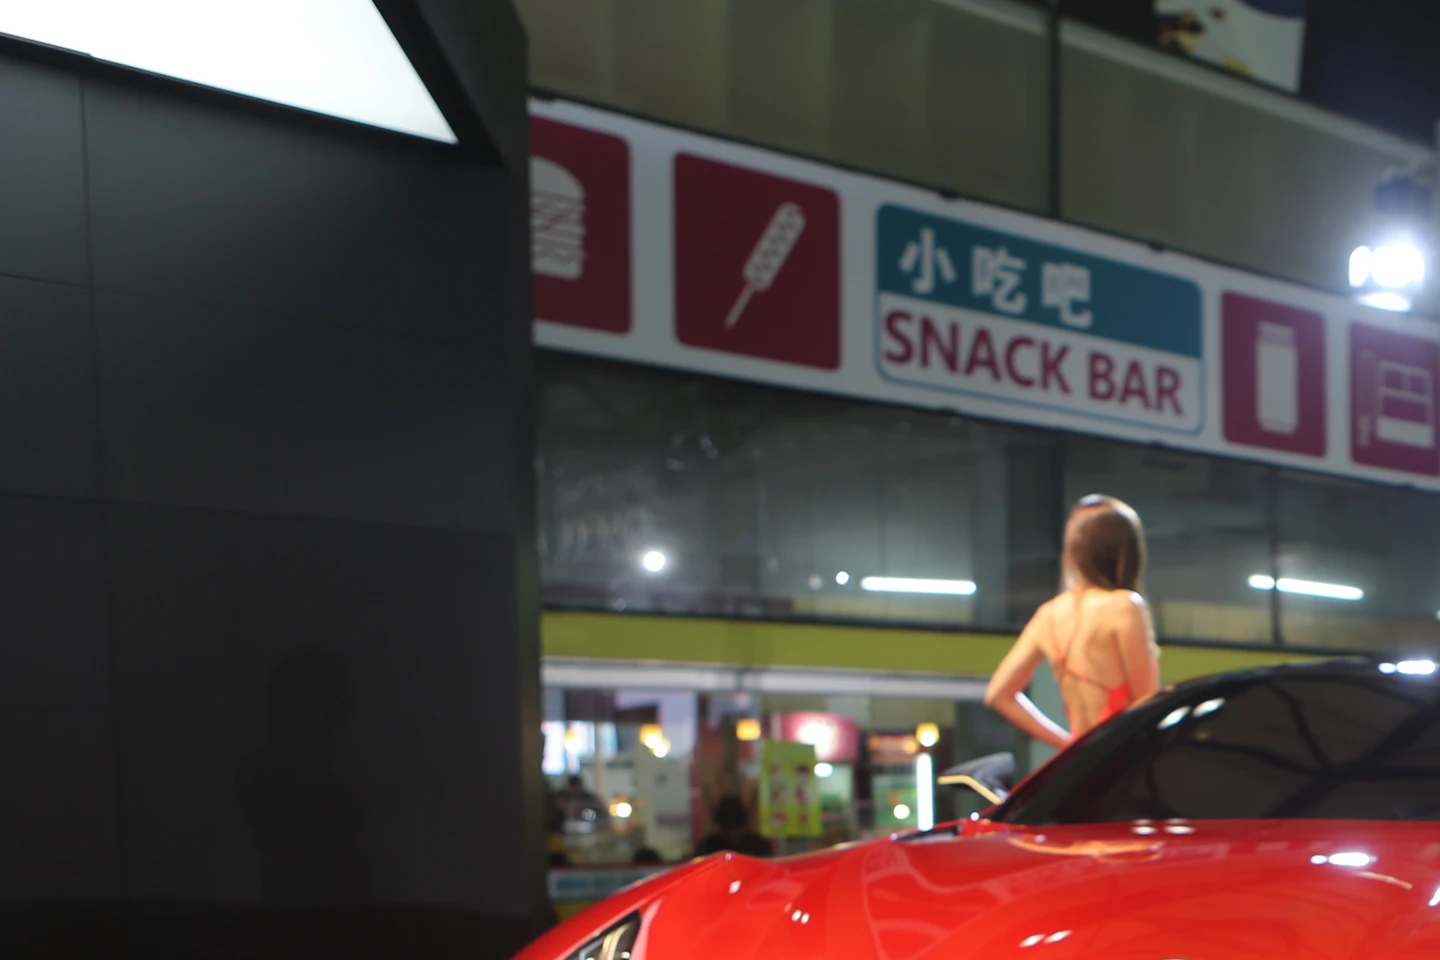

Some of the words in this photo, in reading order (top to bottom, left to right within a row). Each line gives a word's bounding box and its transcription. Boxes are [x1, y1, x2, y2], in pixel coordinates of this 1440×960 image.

[898, 226, 1094, 330] 小吃吧
[883, 308, 1074, 396] SNACK
[1086, 351, 1186, 418] BAR
